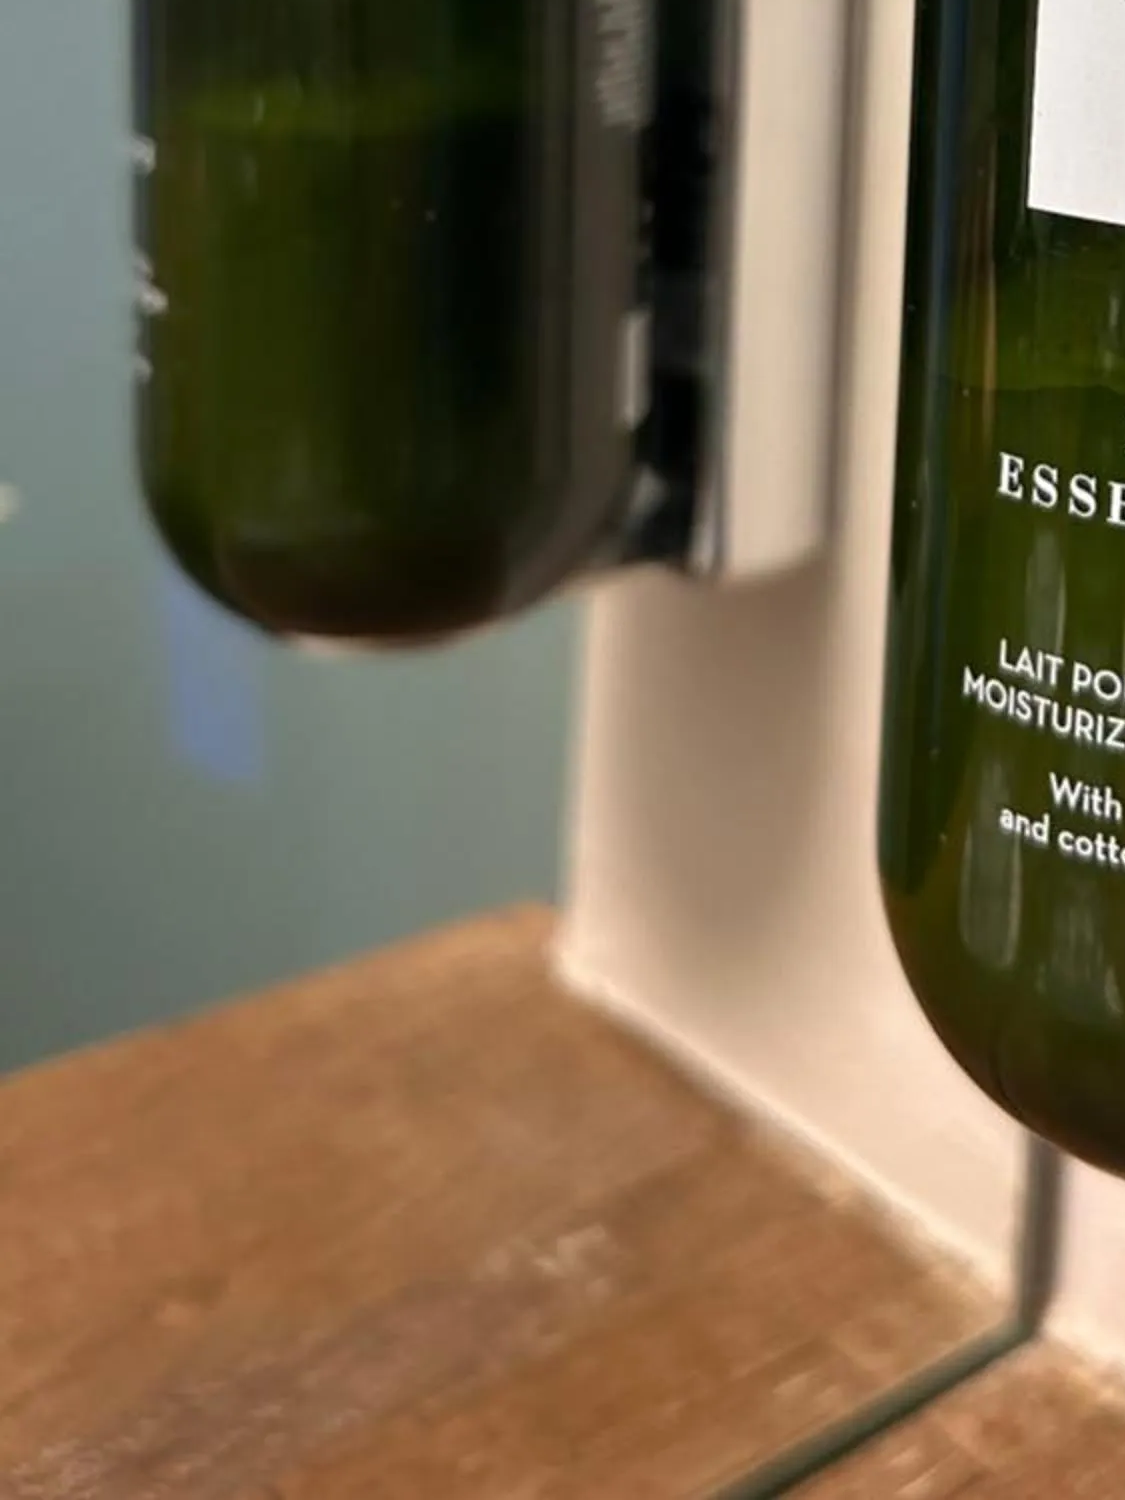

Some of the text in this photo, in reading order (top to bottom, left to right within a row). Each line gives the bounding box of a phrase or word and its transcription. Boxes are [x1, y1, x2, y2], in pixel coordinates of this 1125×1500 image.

[999, 638, 1065, 686] LAIT
[1049, 771, 1123, 821] With
[998, 805, 1049, 844] and
